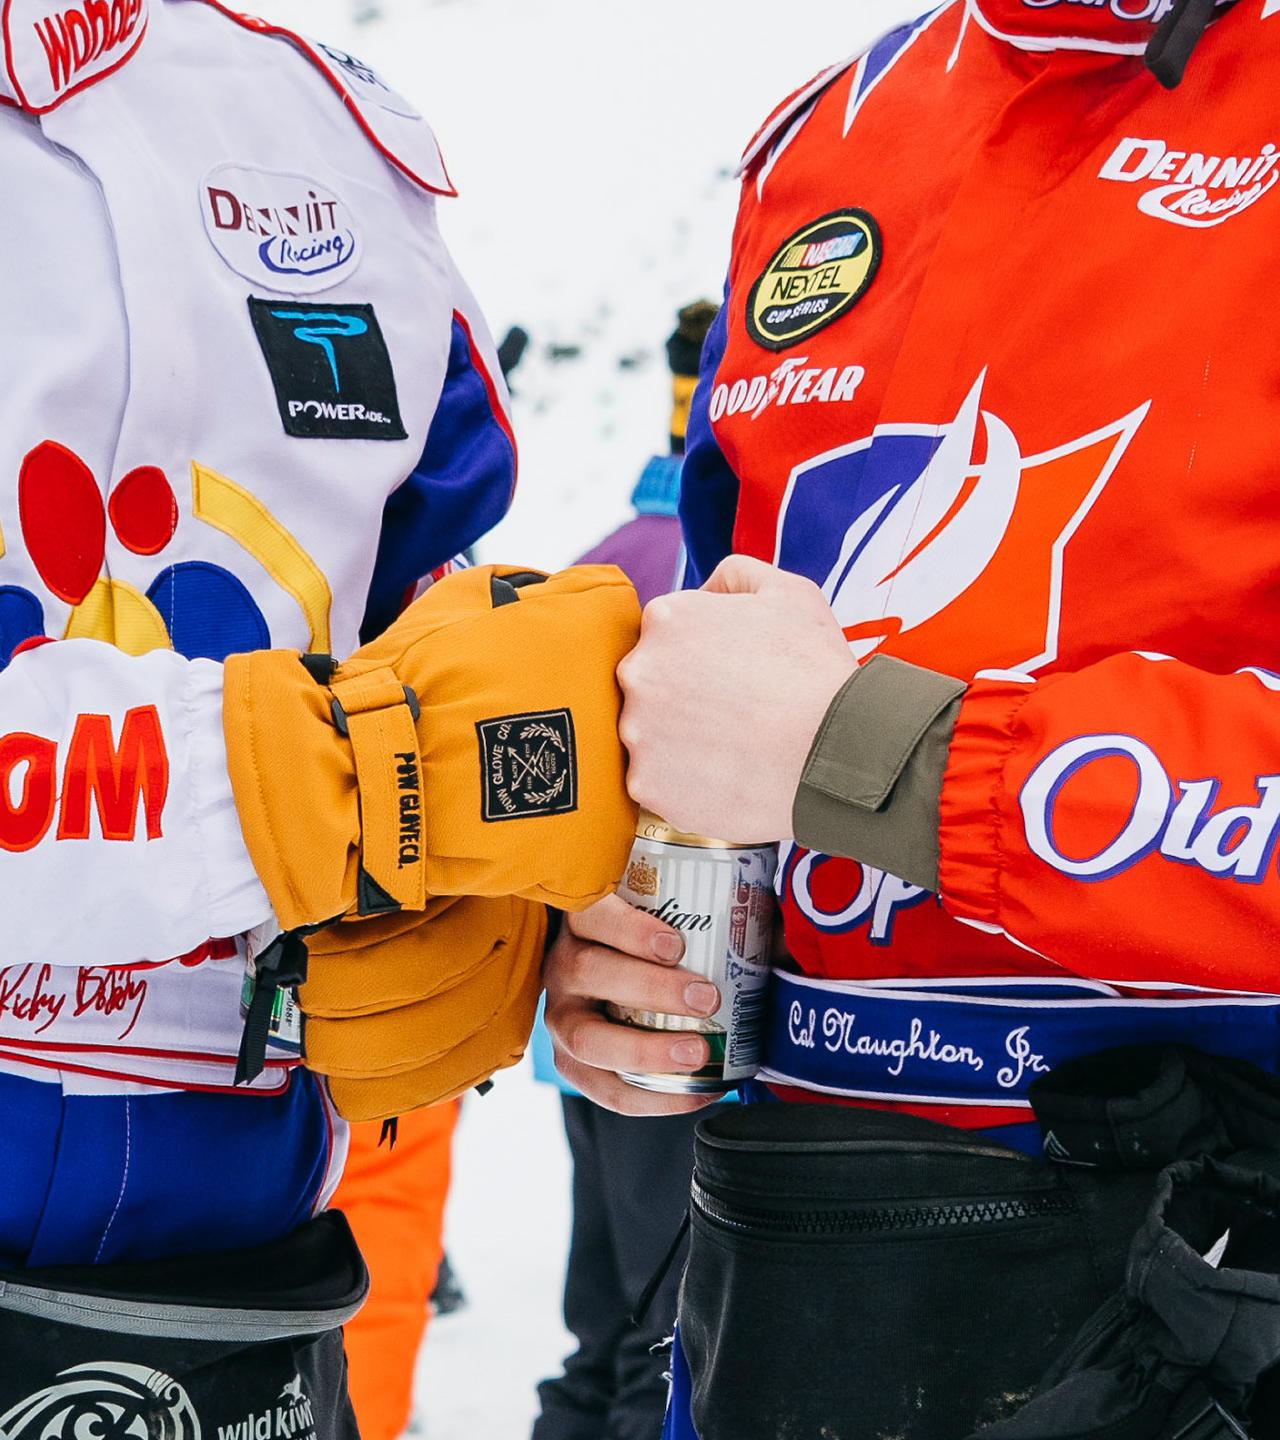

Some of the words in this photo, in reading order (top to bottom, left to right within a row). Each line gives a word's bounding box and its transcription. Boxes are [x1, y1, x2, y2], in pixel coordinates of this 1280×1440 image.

[770, 265, 841, 300] NEXTEL
[709, 364, 865, 422] OODYEAR
[394, 752, 420, 790] POW
[492, 744, 504, 785] GLOVE
[496, 787, 517, 813] POW
[788, 1000, 817, 1049] Cal
